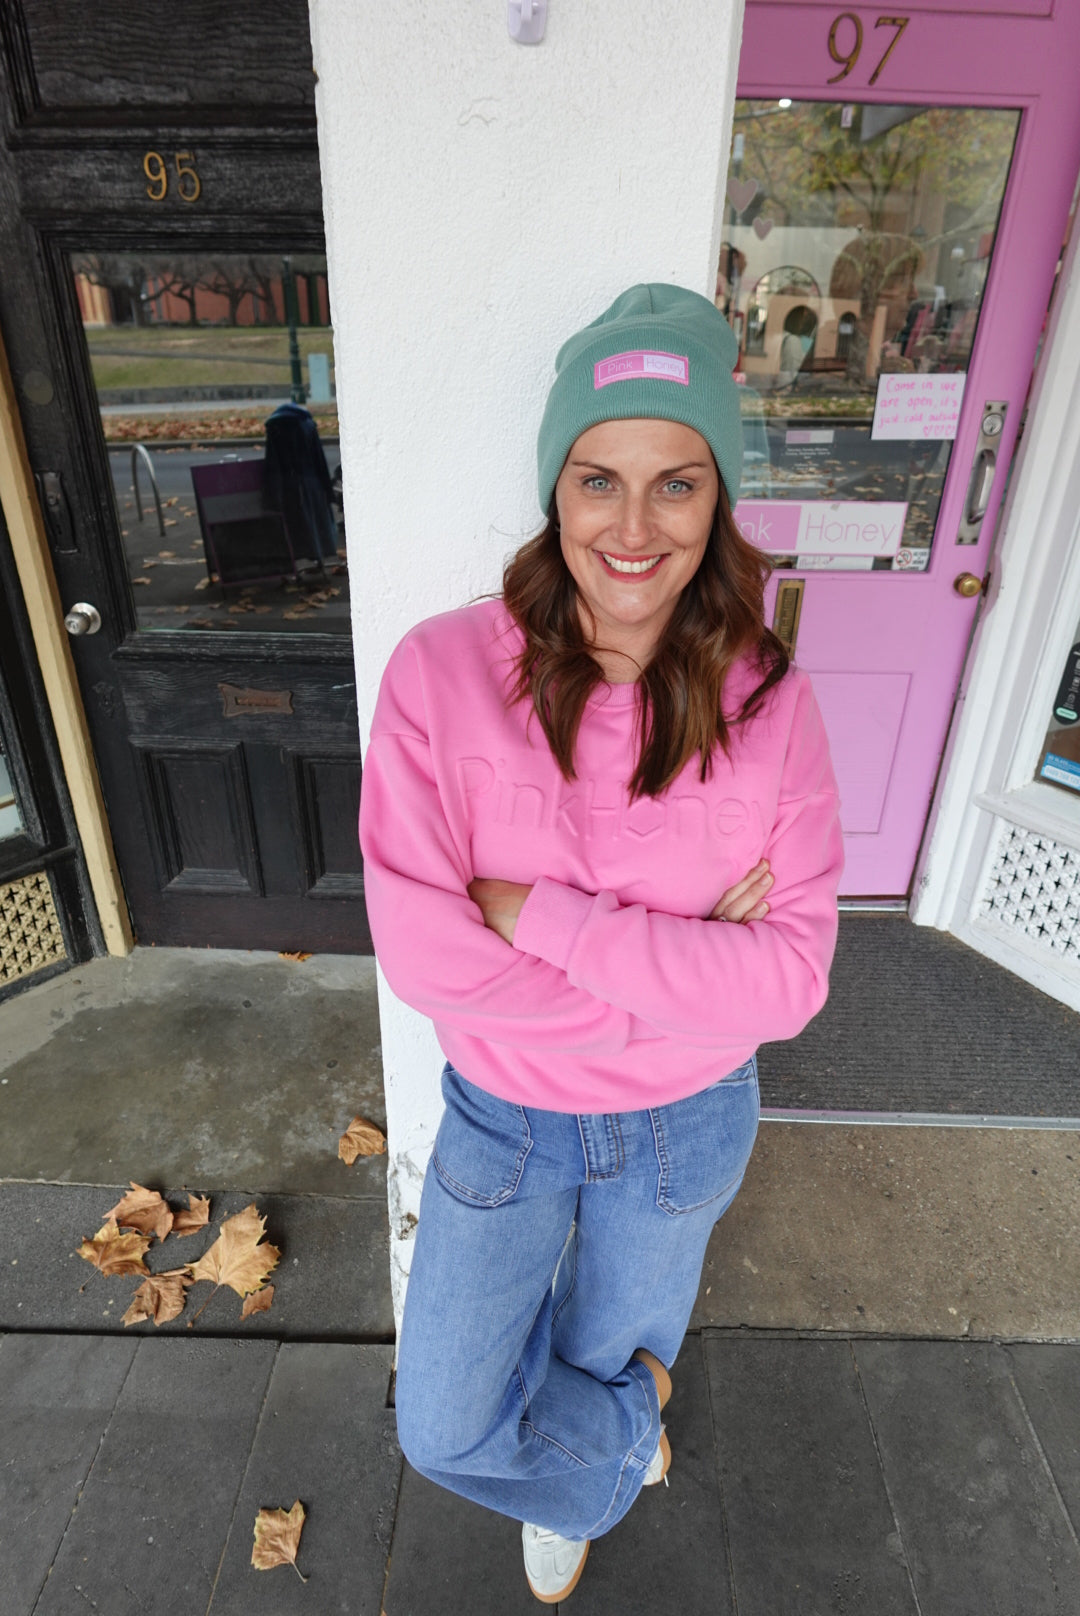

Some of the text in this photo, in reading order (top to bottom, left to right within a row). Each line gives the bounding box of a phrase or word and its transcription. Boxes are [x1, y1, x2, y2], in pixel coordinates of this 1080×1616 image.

[826, 12, 911, 86] 97
[143, 151, 201, 202] 95
[607, 357, 684, 376] Pink Honey
[886, 377, 957, 393] Come in we
[880, 397, 899, 408] are
[735, 511, 896, 550] nk Honey
